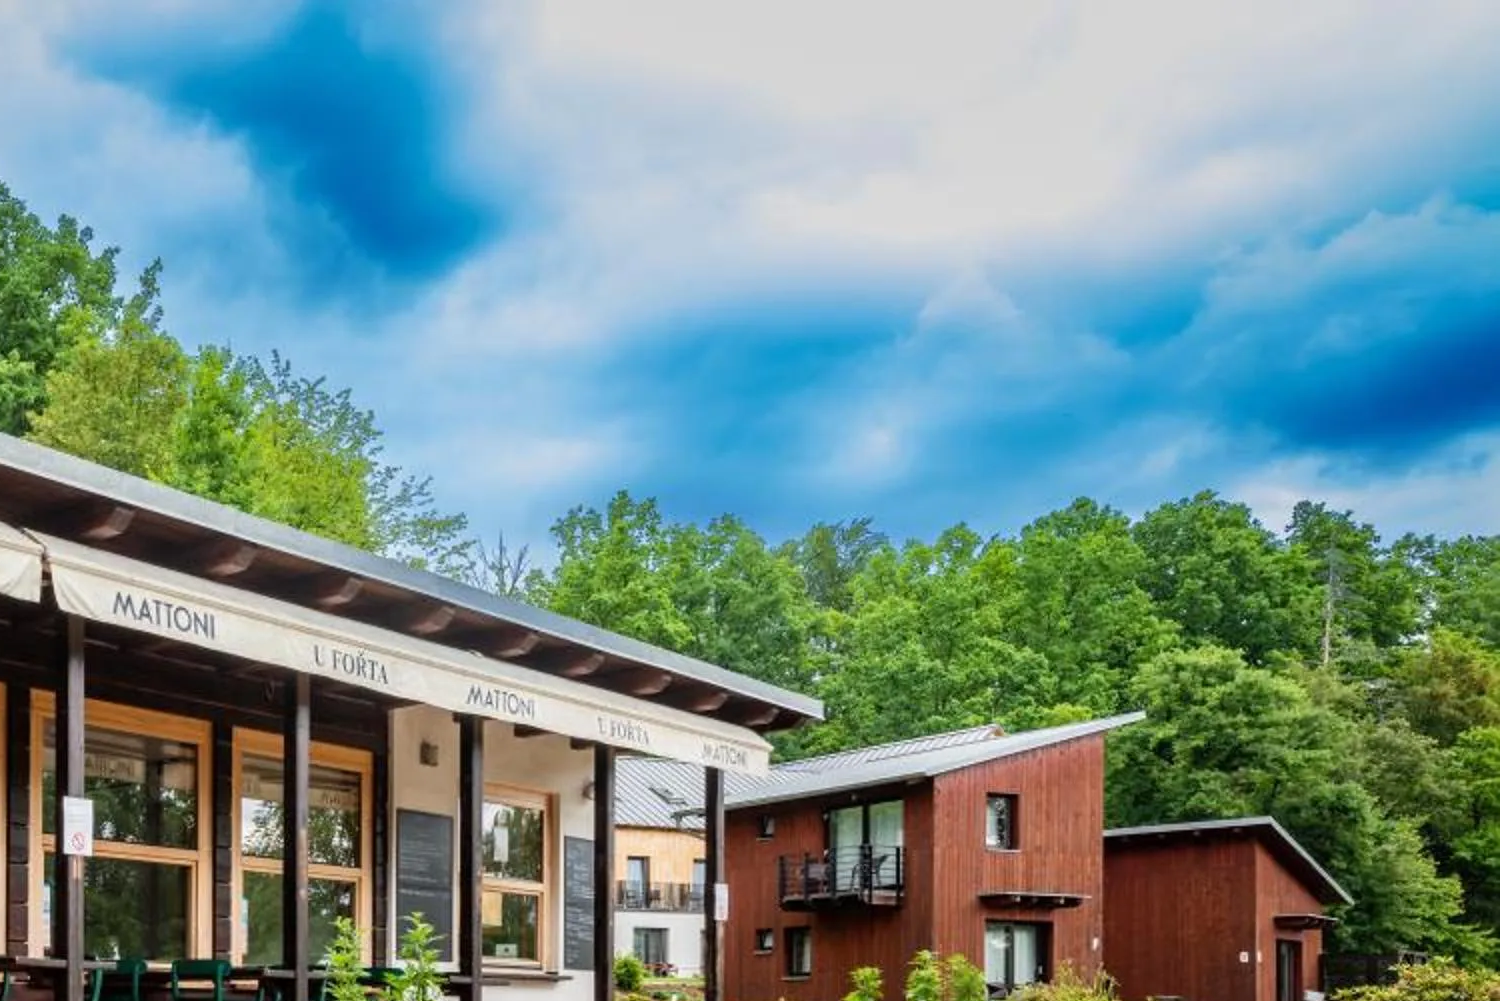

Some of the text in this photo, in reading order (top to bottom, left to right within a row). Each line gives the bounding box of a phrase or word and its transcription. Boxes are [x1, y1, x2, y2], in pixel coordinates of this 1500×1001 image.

[113, 592, 215, 640] MATTONI
[314, 645, 389, 684] U FOŘTA
[466, 684, 536, 719] MATTONI
